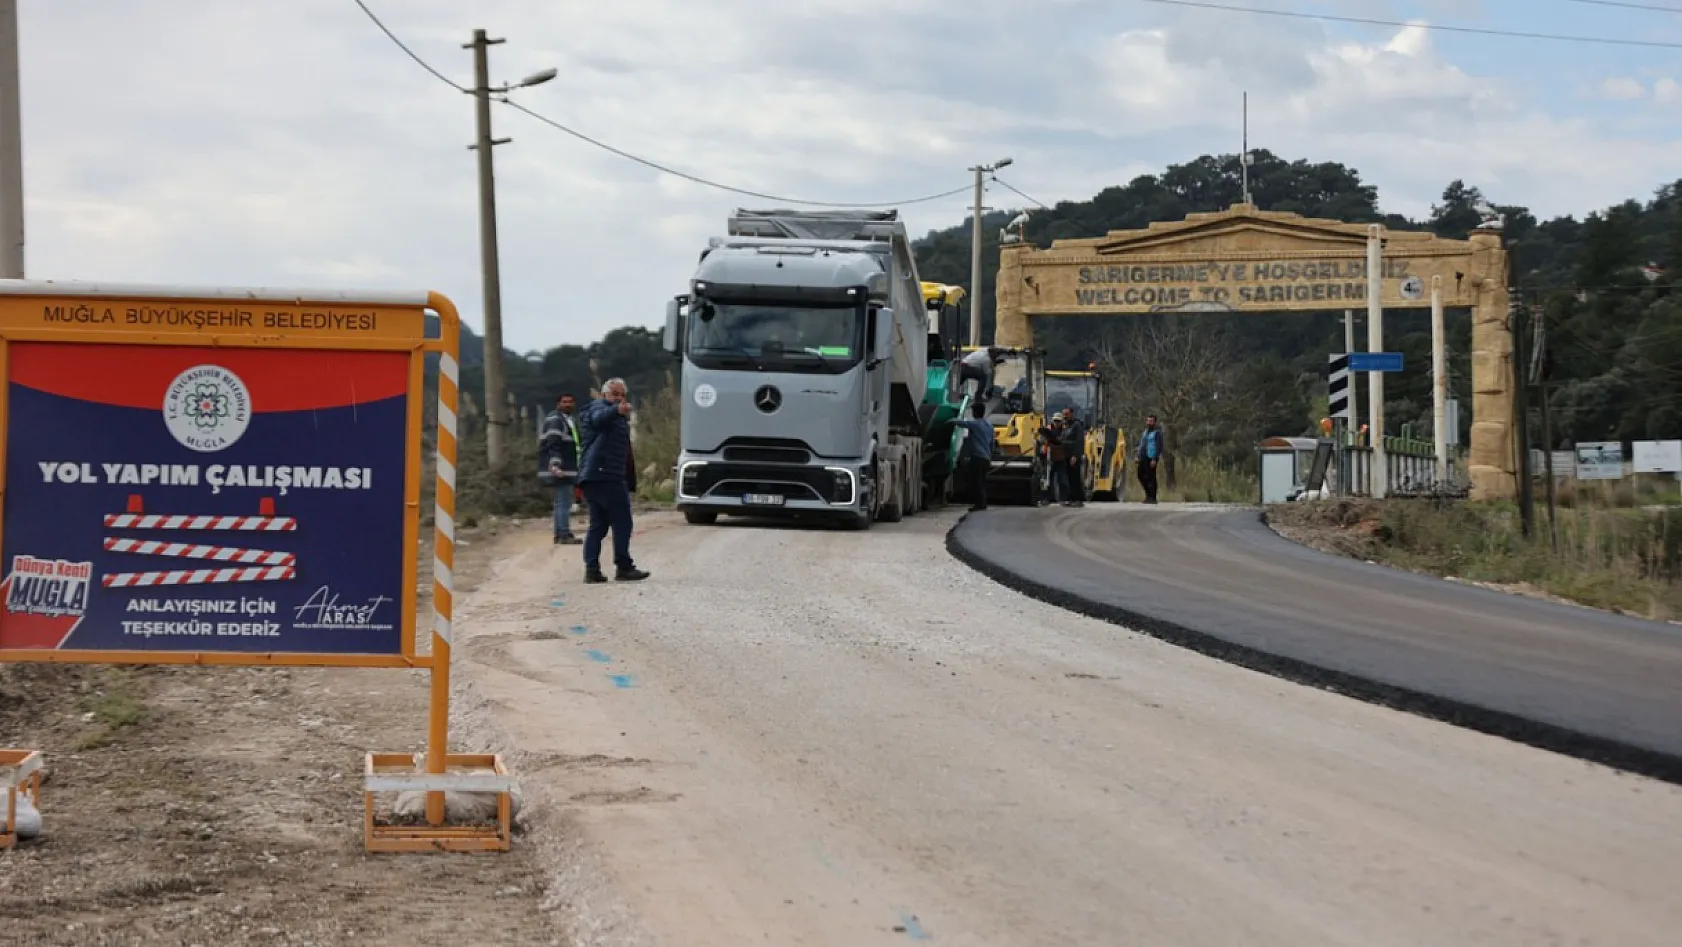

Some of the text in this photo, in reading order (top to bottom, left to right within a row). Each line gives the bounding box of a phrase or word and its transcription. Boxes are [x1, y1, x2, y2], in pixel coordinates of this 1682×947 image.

[1076, 283, 1369, 305] WELCOME TO SARIGERM
[44, 305, 376, 330] MUĞLA BÜYÜKŞEHİR BELEDİYESİ
[38, 461, 372, 496] YOL YAPIM ÇALIŞMASI
[15, 557, 89, 578] Dünya Kenti
[126, 596, 276, 617] ANLAYIŞINIZ İÇİN
[293, 585, 394, 624] Ahmet
[121, 619, 214, 638] TEŞEKKÜR
[216, 619, 282, 636] EDERİZ
[322, 612, 366, 624] ARAS
